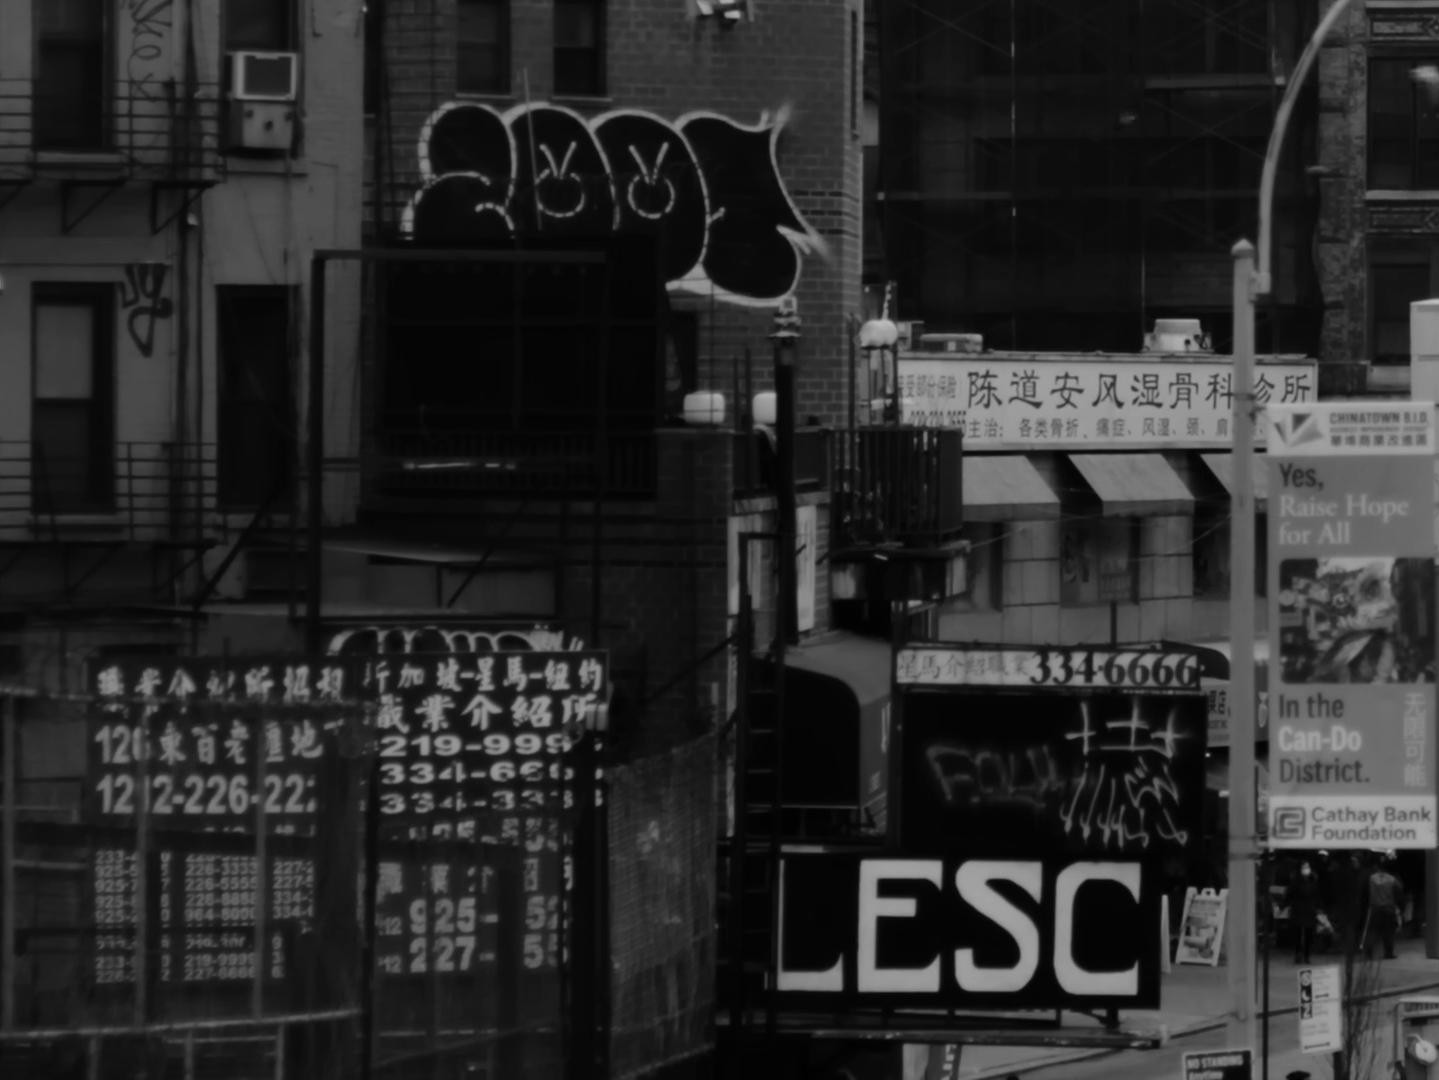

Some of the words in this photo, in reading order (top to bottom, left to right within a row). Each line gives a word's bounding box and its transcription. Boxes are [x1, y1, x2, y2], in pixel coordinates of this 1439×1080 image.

[1279, 461, 1325, 491] Yes,
[1280, 493, 1339, 517] Raise
[1346, 493, 1410, 524] Hope
[1279, 521, 1312, 545] for
[1317, 521, 1351, 545] All
[1279, 694, 1300, 719] In
[1307, 692, 1344, 719] the
[1278, 724, 1363, 752] Can-Do
[1279, 757, 1371, 783] District.
[1312, 806, 1379, 824] Cathay
[1384, 806, 1431, 822] Bank
[1312, 825, 1416, 841] Foundation
